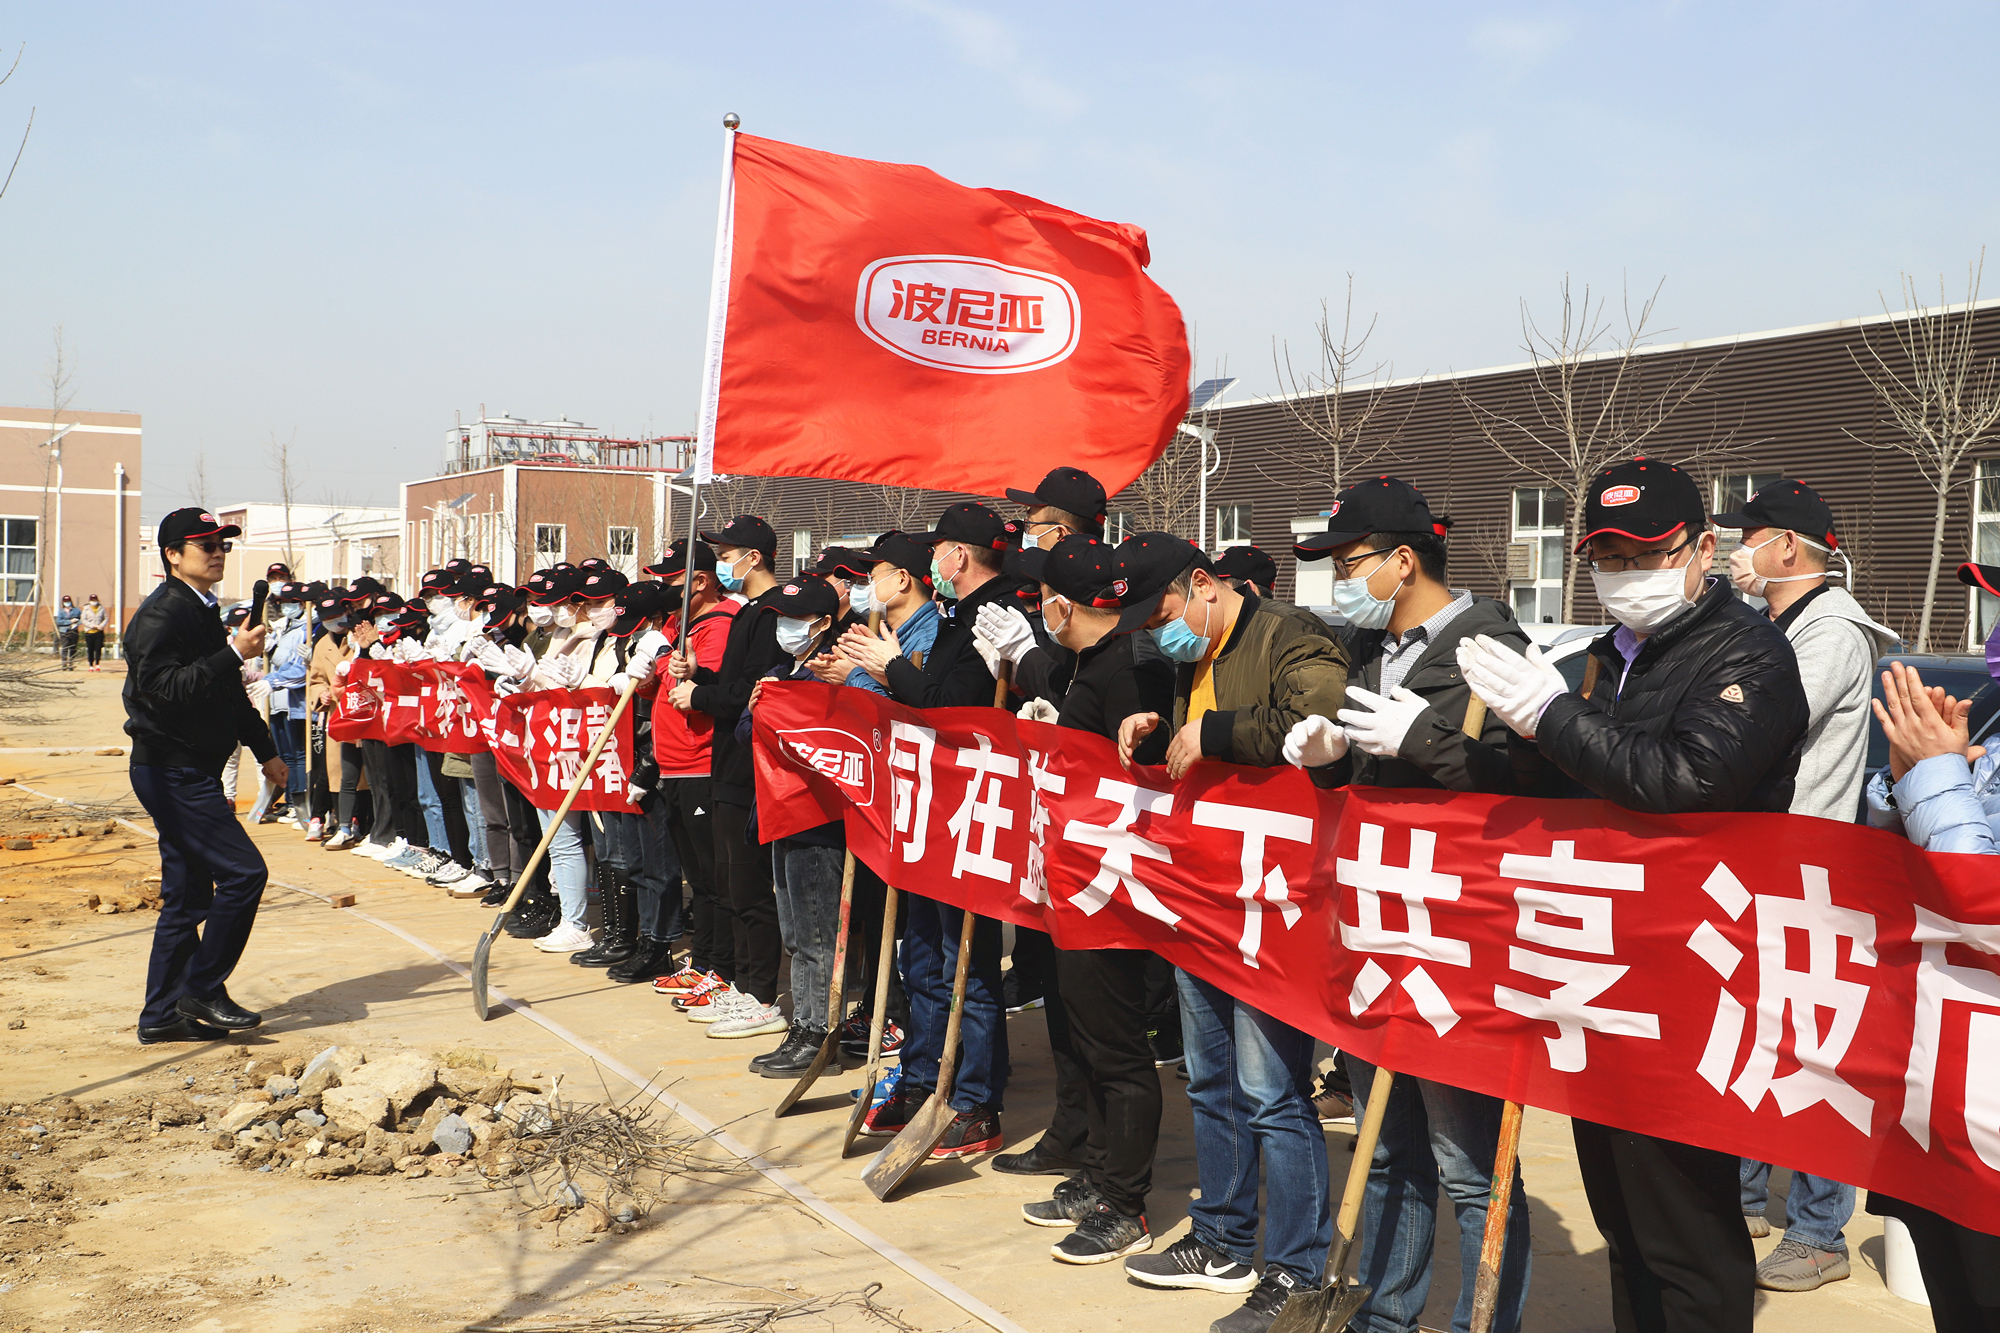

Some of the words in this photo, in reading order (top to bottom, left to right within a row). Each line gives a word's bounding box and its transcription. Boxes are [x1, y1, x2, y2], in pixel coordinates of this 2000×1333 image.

[888, 278, 1045, 334] 波尼亚
[921, 329, 1010, 353] BERNIA
